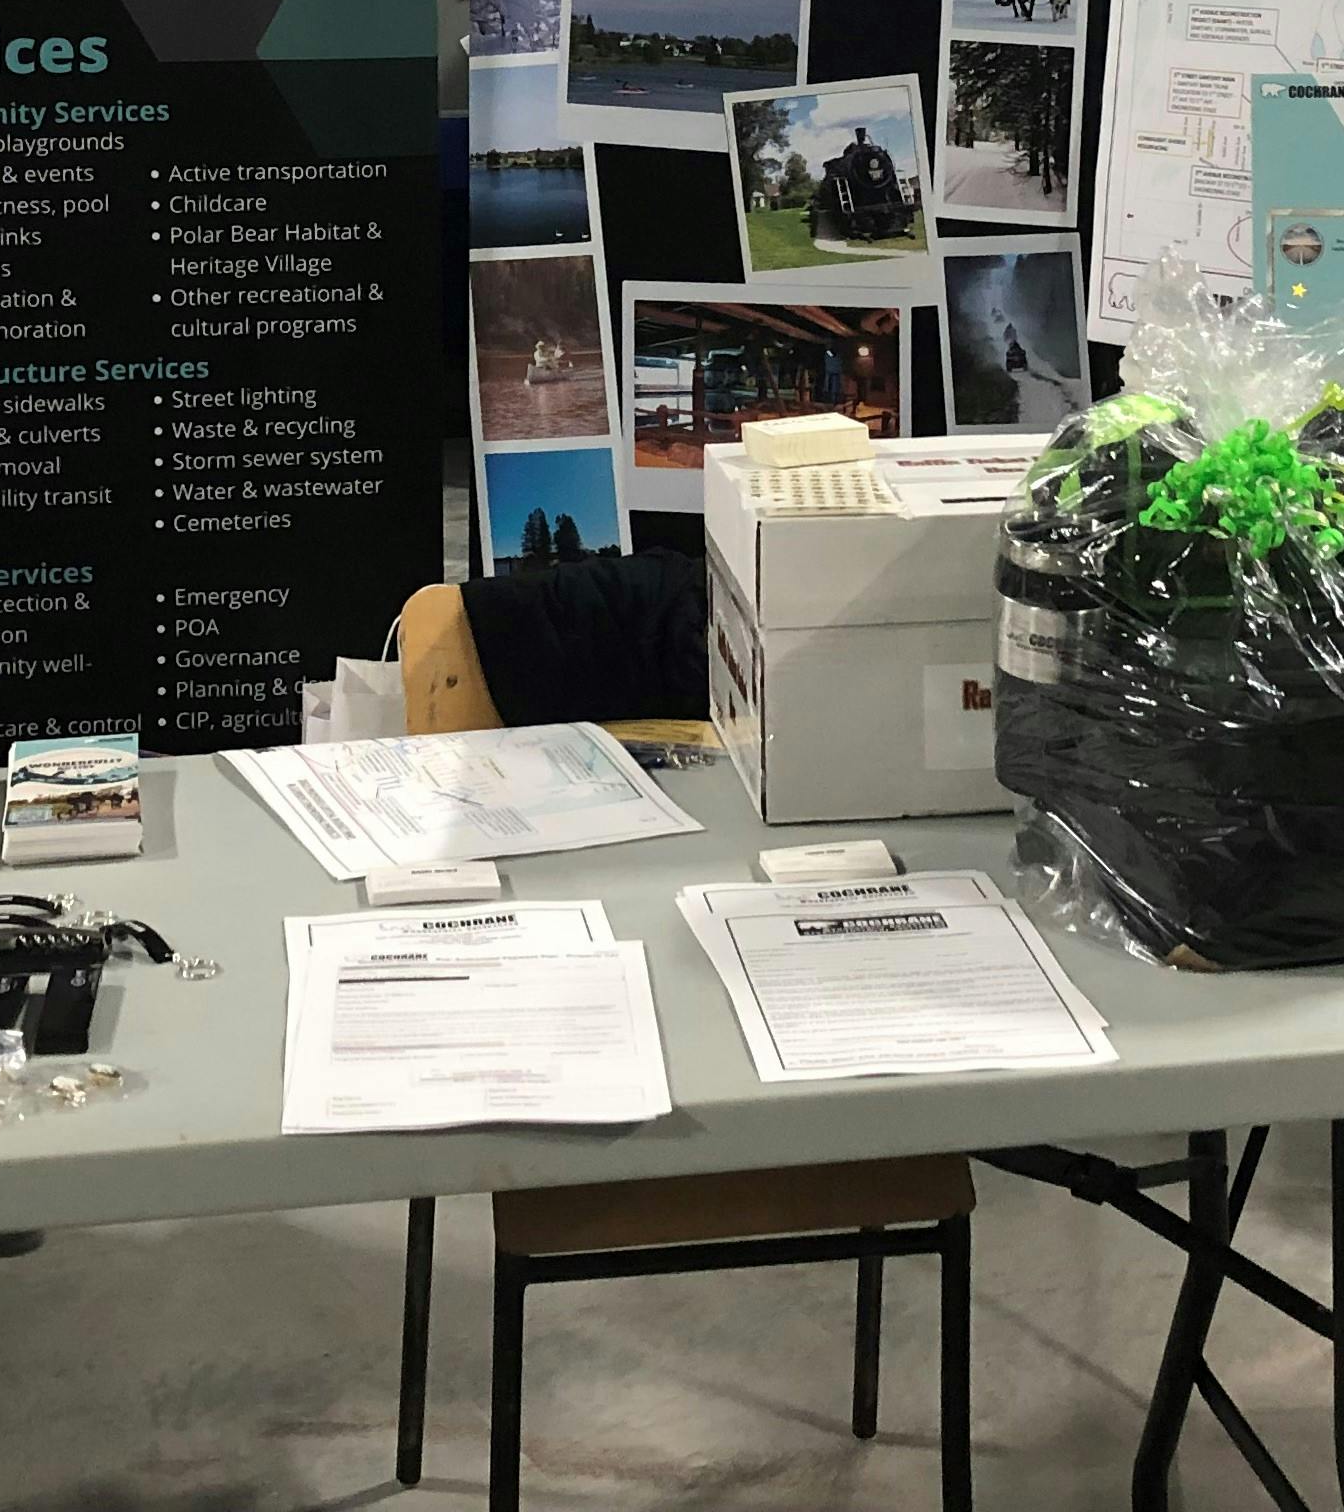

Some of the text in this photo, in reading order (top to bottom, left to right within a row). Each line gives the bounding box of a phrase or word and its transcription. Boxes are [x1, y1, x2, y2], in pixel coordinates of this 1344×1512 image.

[55, 99, 172, 123] Services
[24, 166, 94, 183] events
[168, 161, 387, 184] Active transportation
[95, 360, 209, 382] Services
[3, 393, 105, 414] sidewalks
[175, 588, 289, 609] Emergency
